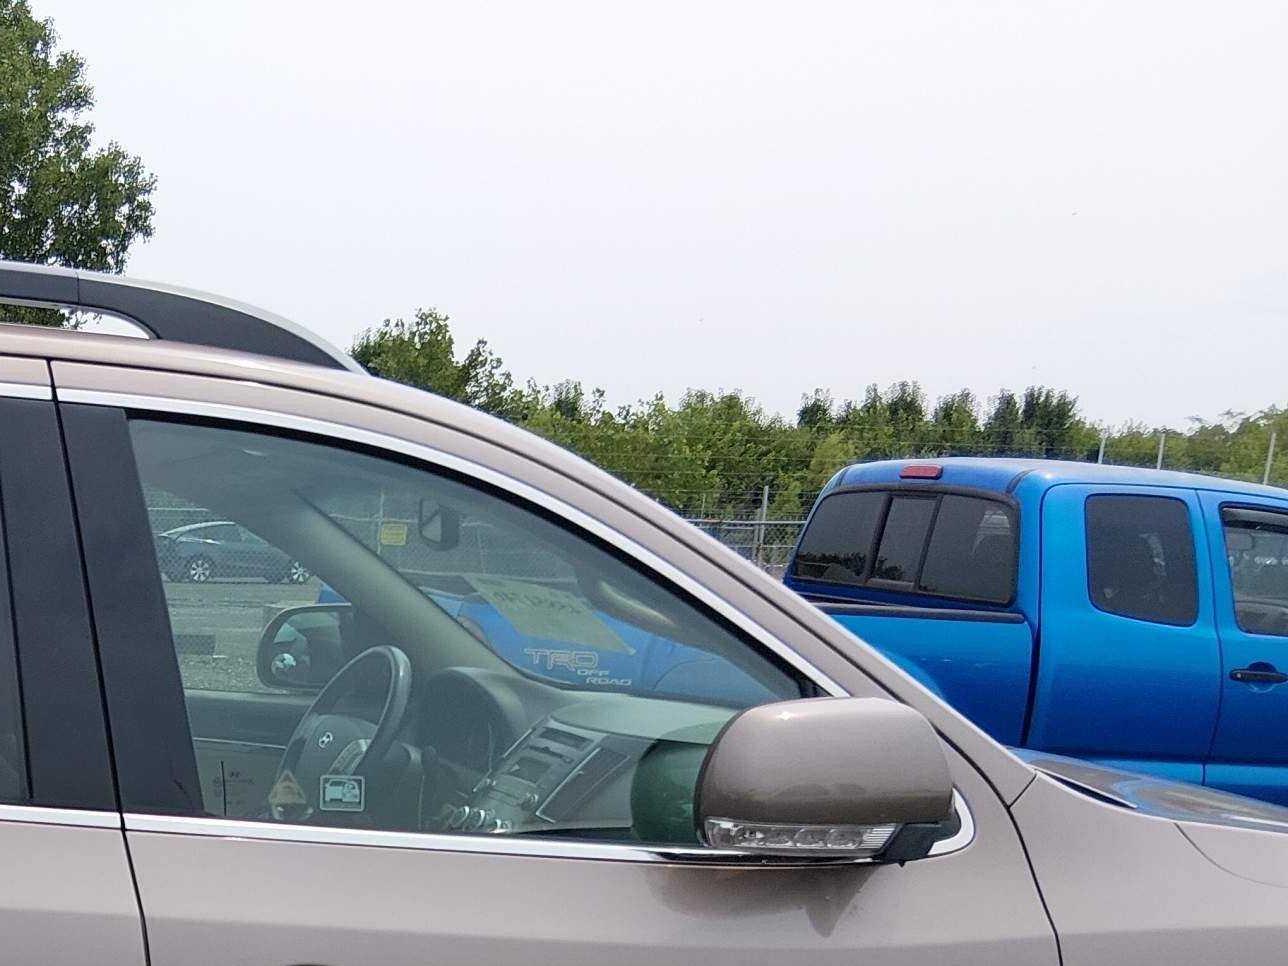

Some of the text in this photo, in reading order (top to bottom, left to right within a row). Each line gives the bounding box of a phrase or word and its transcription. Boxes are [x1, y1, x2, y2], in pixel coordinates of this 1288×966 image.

[523, 648, 599, 671] TRD
[576, 668, 609, 676] OFF
[586, 676, 632, 686] ROAD
